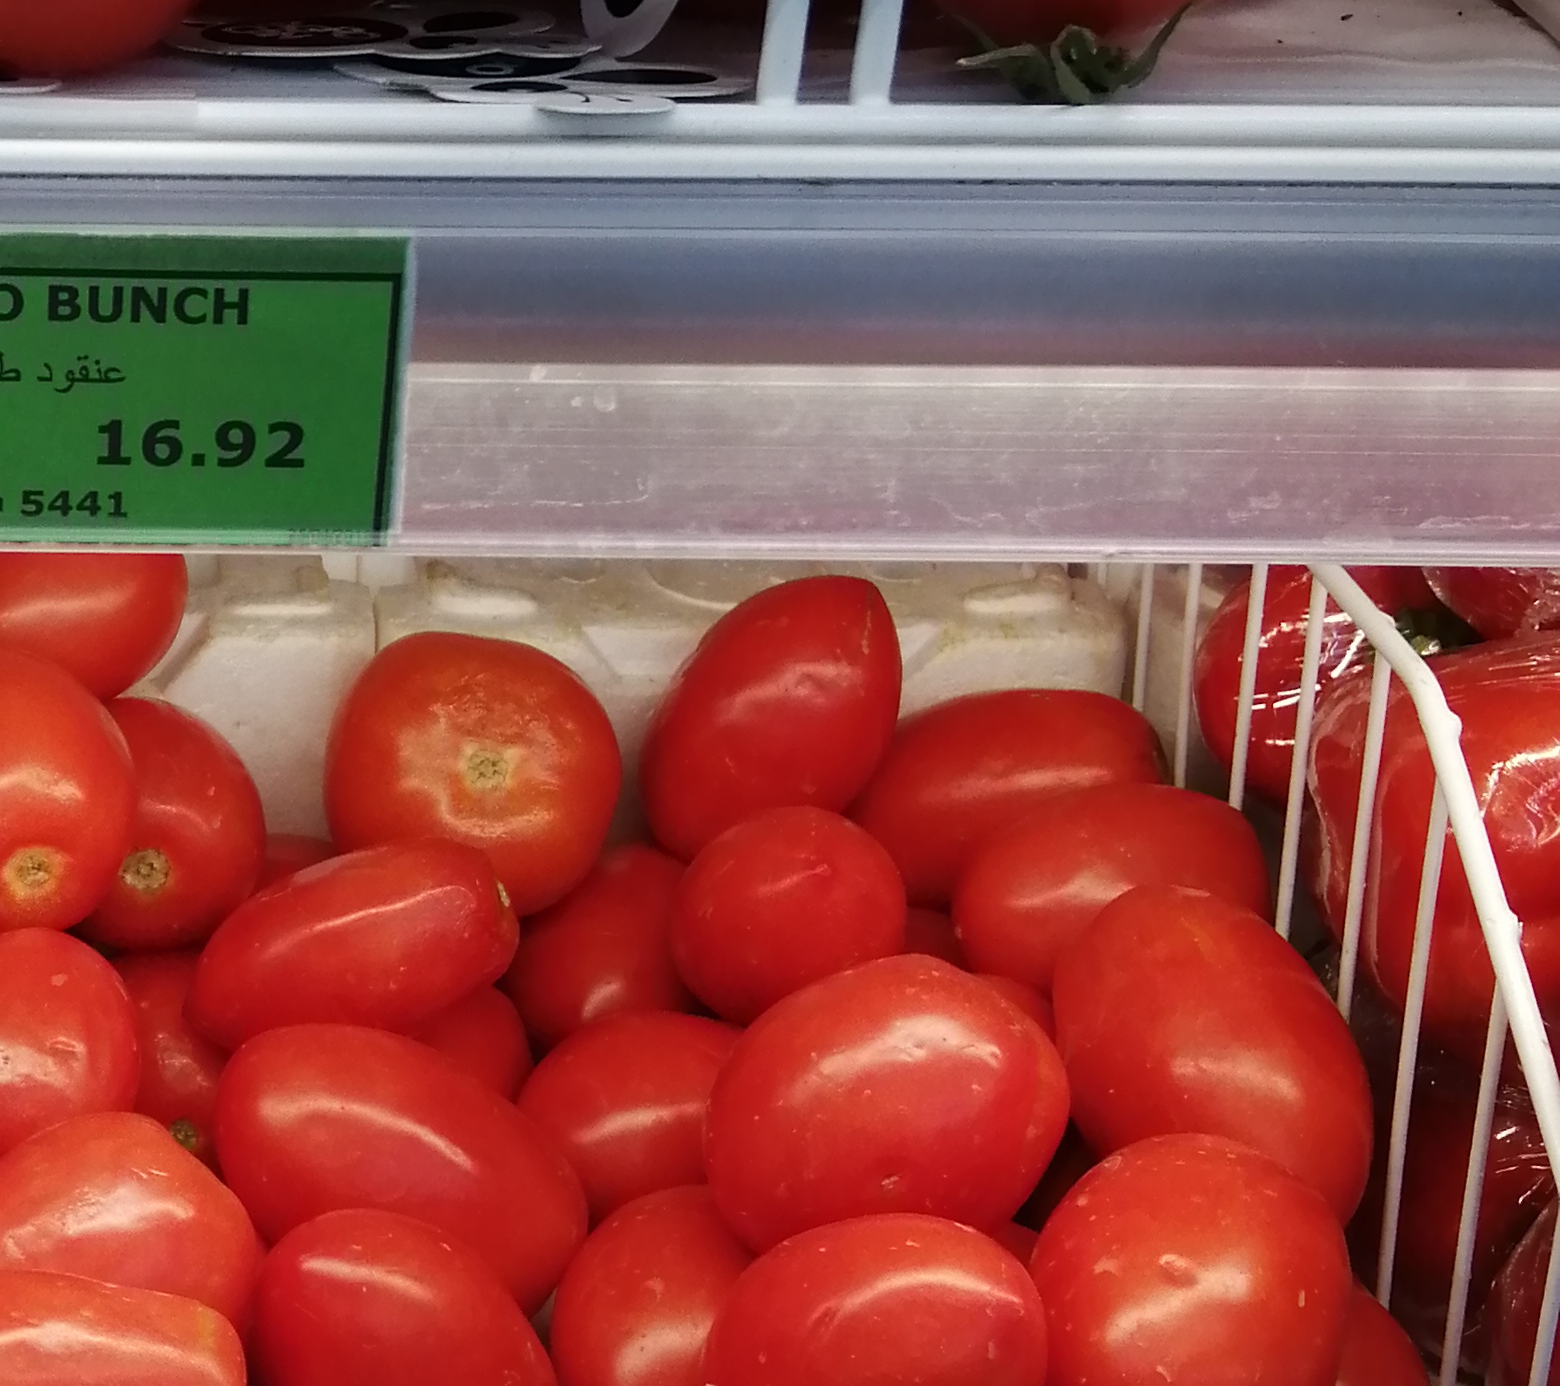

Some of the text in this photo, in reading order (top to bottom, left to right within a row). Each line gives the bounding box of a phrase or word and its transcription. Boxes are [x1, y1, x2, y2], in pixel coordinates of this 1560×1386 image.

[47, 284, 250, 326] BUNCH
[36, 353, 127, 394] عنقود
[96, 419, 305, 469] 16.92
[20, 489, 128, 518] 5441
